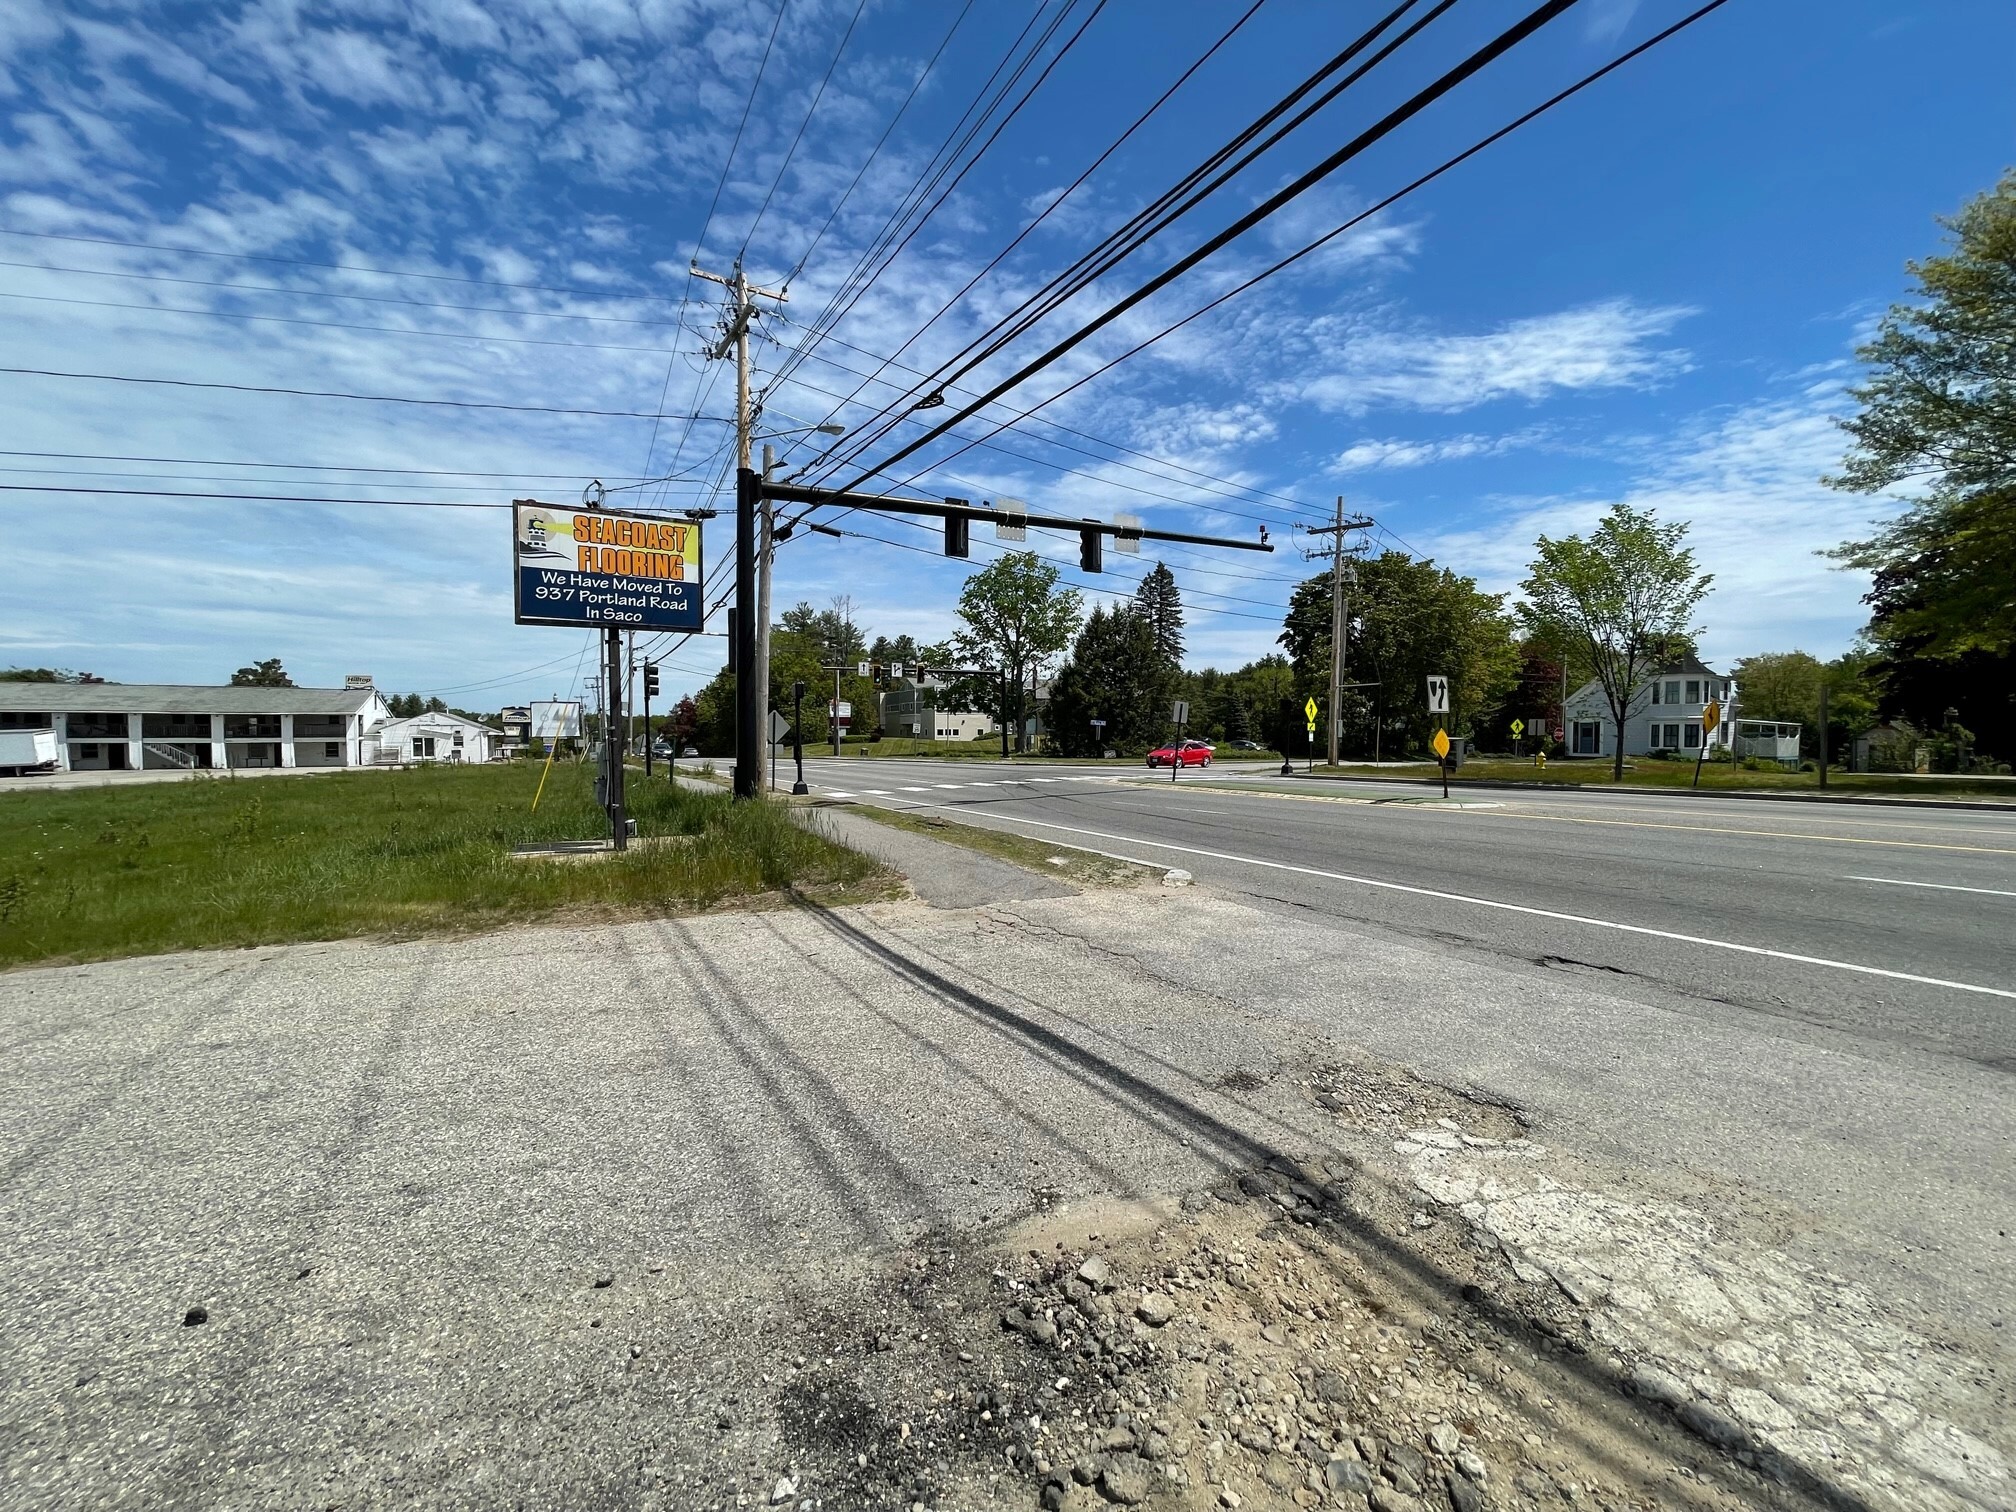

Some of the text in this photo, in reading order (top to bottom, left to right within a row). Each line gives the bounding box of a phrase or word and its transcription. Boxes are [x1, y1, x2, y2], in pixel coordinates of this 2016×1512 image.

[573, 515, 687, 552] SEACOAST
[577, 545, 684, 580] FLOORING
[541, 571, 683, 596] We Have Moved To
[535, 586, 688, 611] 937 Portland Road
[586, 606, 642, 622] In Saco
